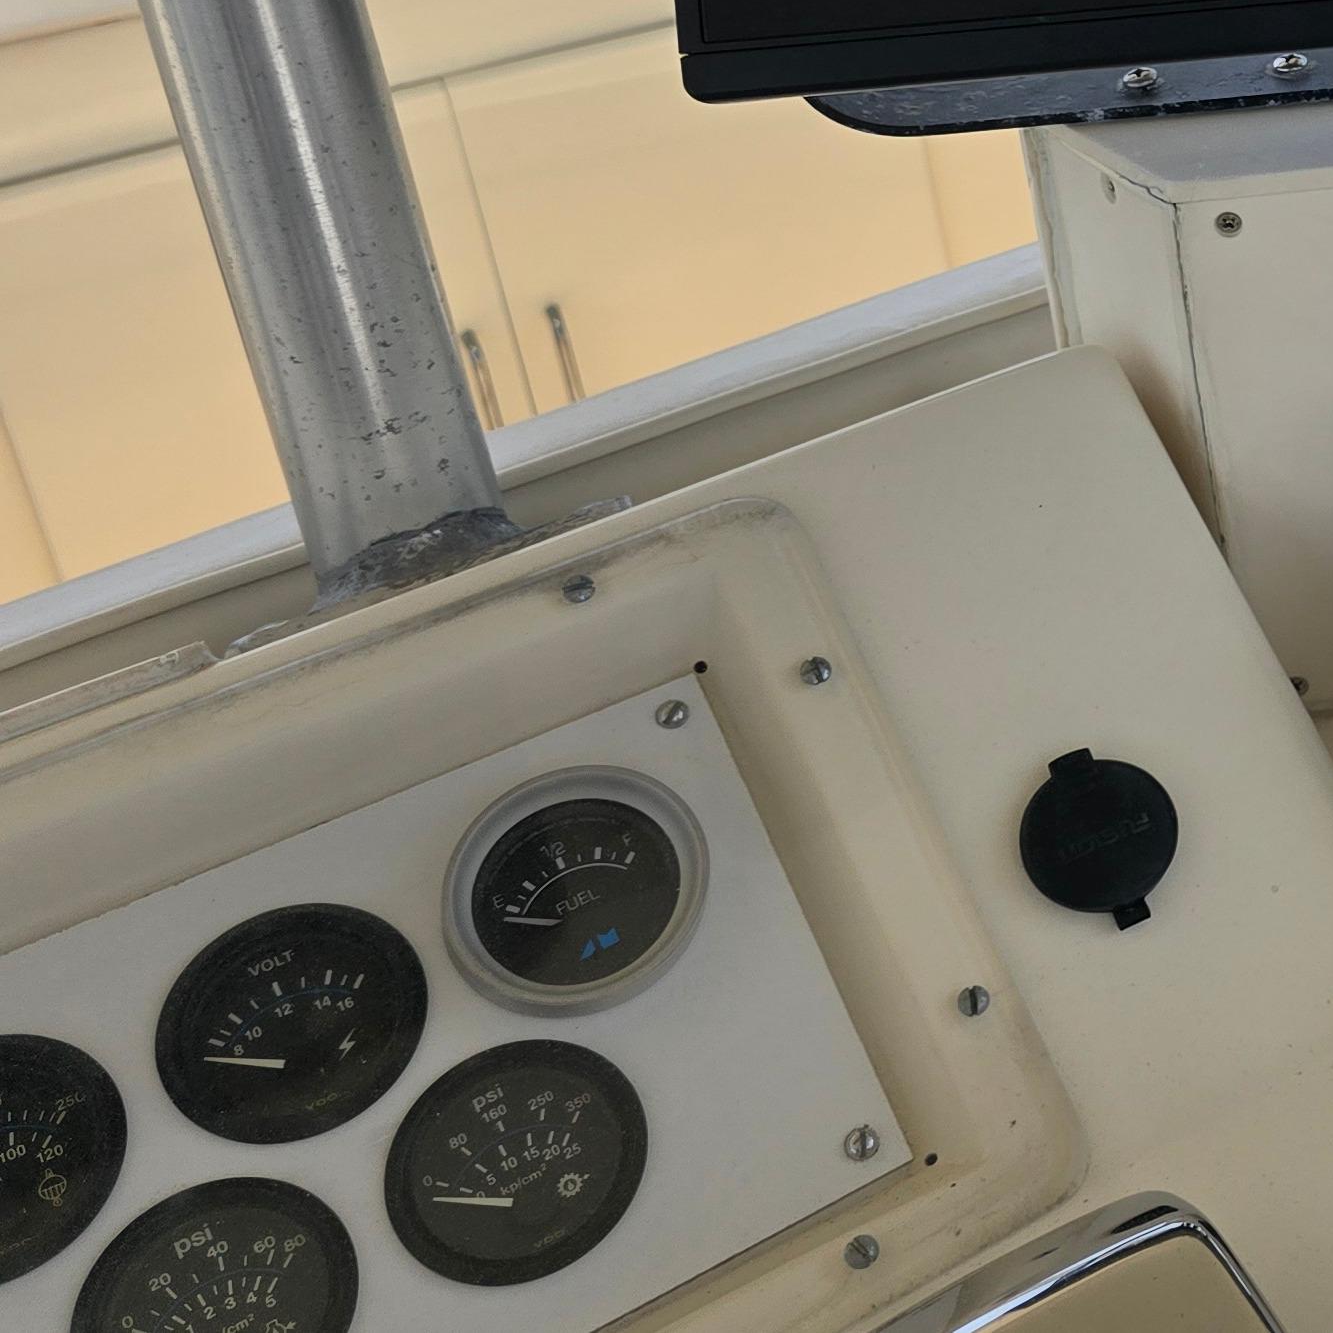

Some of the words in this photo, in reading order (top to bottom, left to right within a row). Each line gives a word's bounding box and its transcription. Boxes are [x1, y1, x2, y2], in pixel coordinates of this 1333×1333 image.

[492, 893, 505, 909] E
[555, 889, 601, 916] FUEL
[247, 949, 295, 978] VOLT
[233, 1043, 245, 1057] 8
[244, 1025, 263, 1041] 10
[273, 1002, 293, 1018] 12
[313, 995, 332, 1011] 14
[336, 996, 355, 1013] 16
[471, 1083, 504, 1114] psi
[448, 1132, 468, 1150] 80
[481, 1103, 508, 1124] 160
[527, 1090, 555, 1111] 250
[565, 1091, 592, 1113] 350
[36, 1144, 64, 1164] 120
[485, 1173, 497, 1187] 5
[499, 1156, 519, 1172] 10
[523, 1147, 541, 1164] 15
[542, 1145, 562, 1162] 20
[563, 1142, 583, 1160] 25
[172, 1222, 214, 1260] psi
[121, 1314, 134, 1329] 0
[148, 1272, 172, 1292] 20
[206, 1239, 229, 1259] 40
[252, 1235, 276, 1254] 60
[283, 1233, 307, 1253] 80
[203, 1305, 217, 1321] 2
[224, 1295, 237, 1310] 3
[246, 1291, 258, 1306] 4
[265, 1294, 278, 1309] 5
